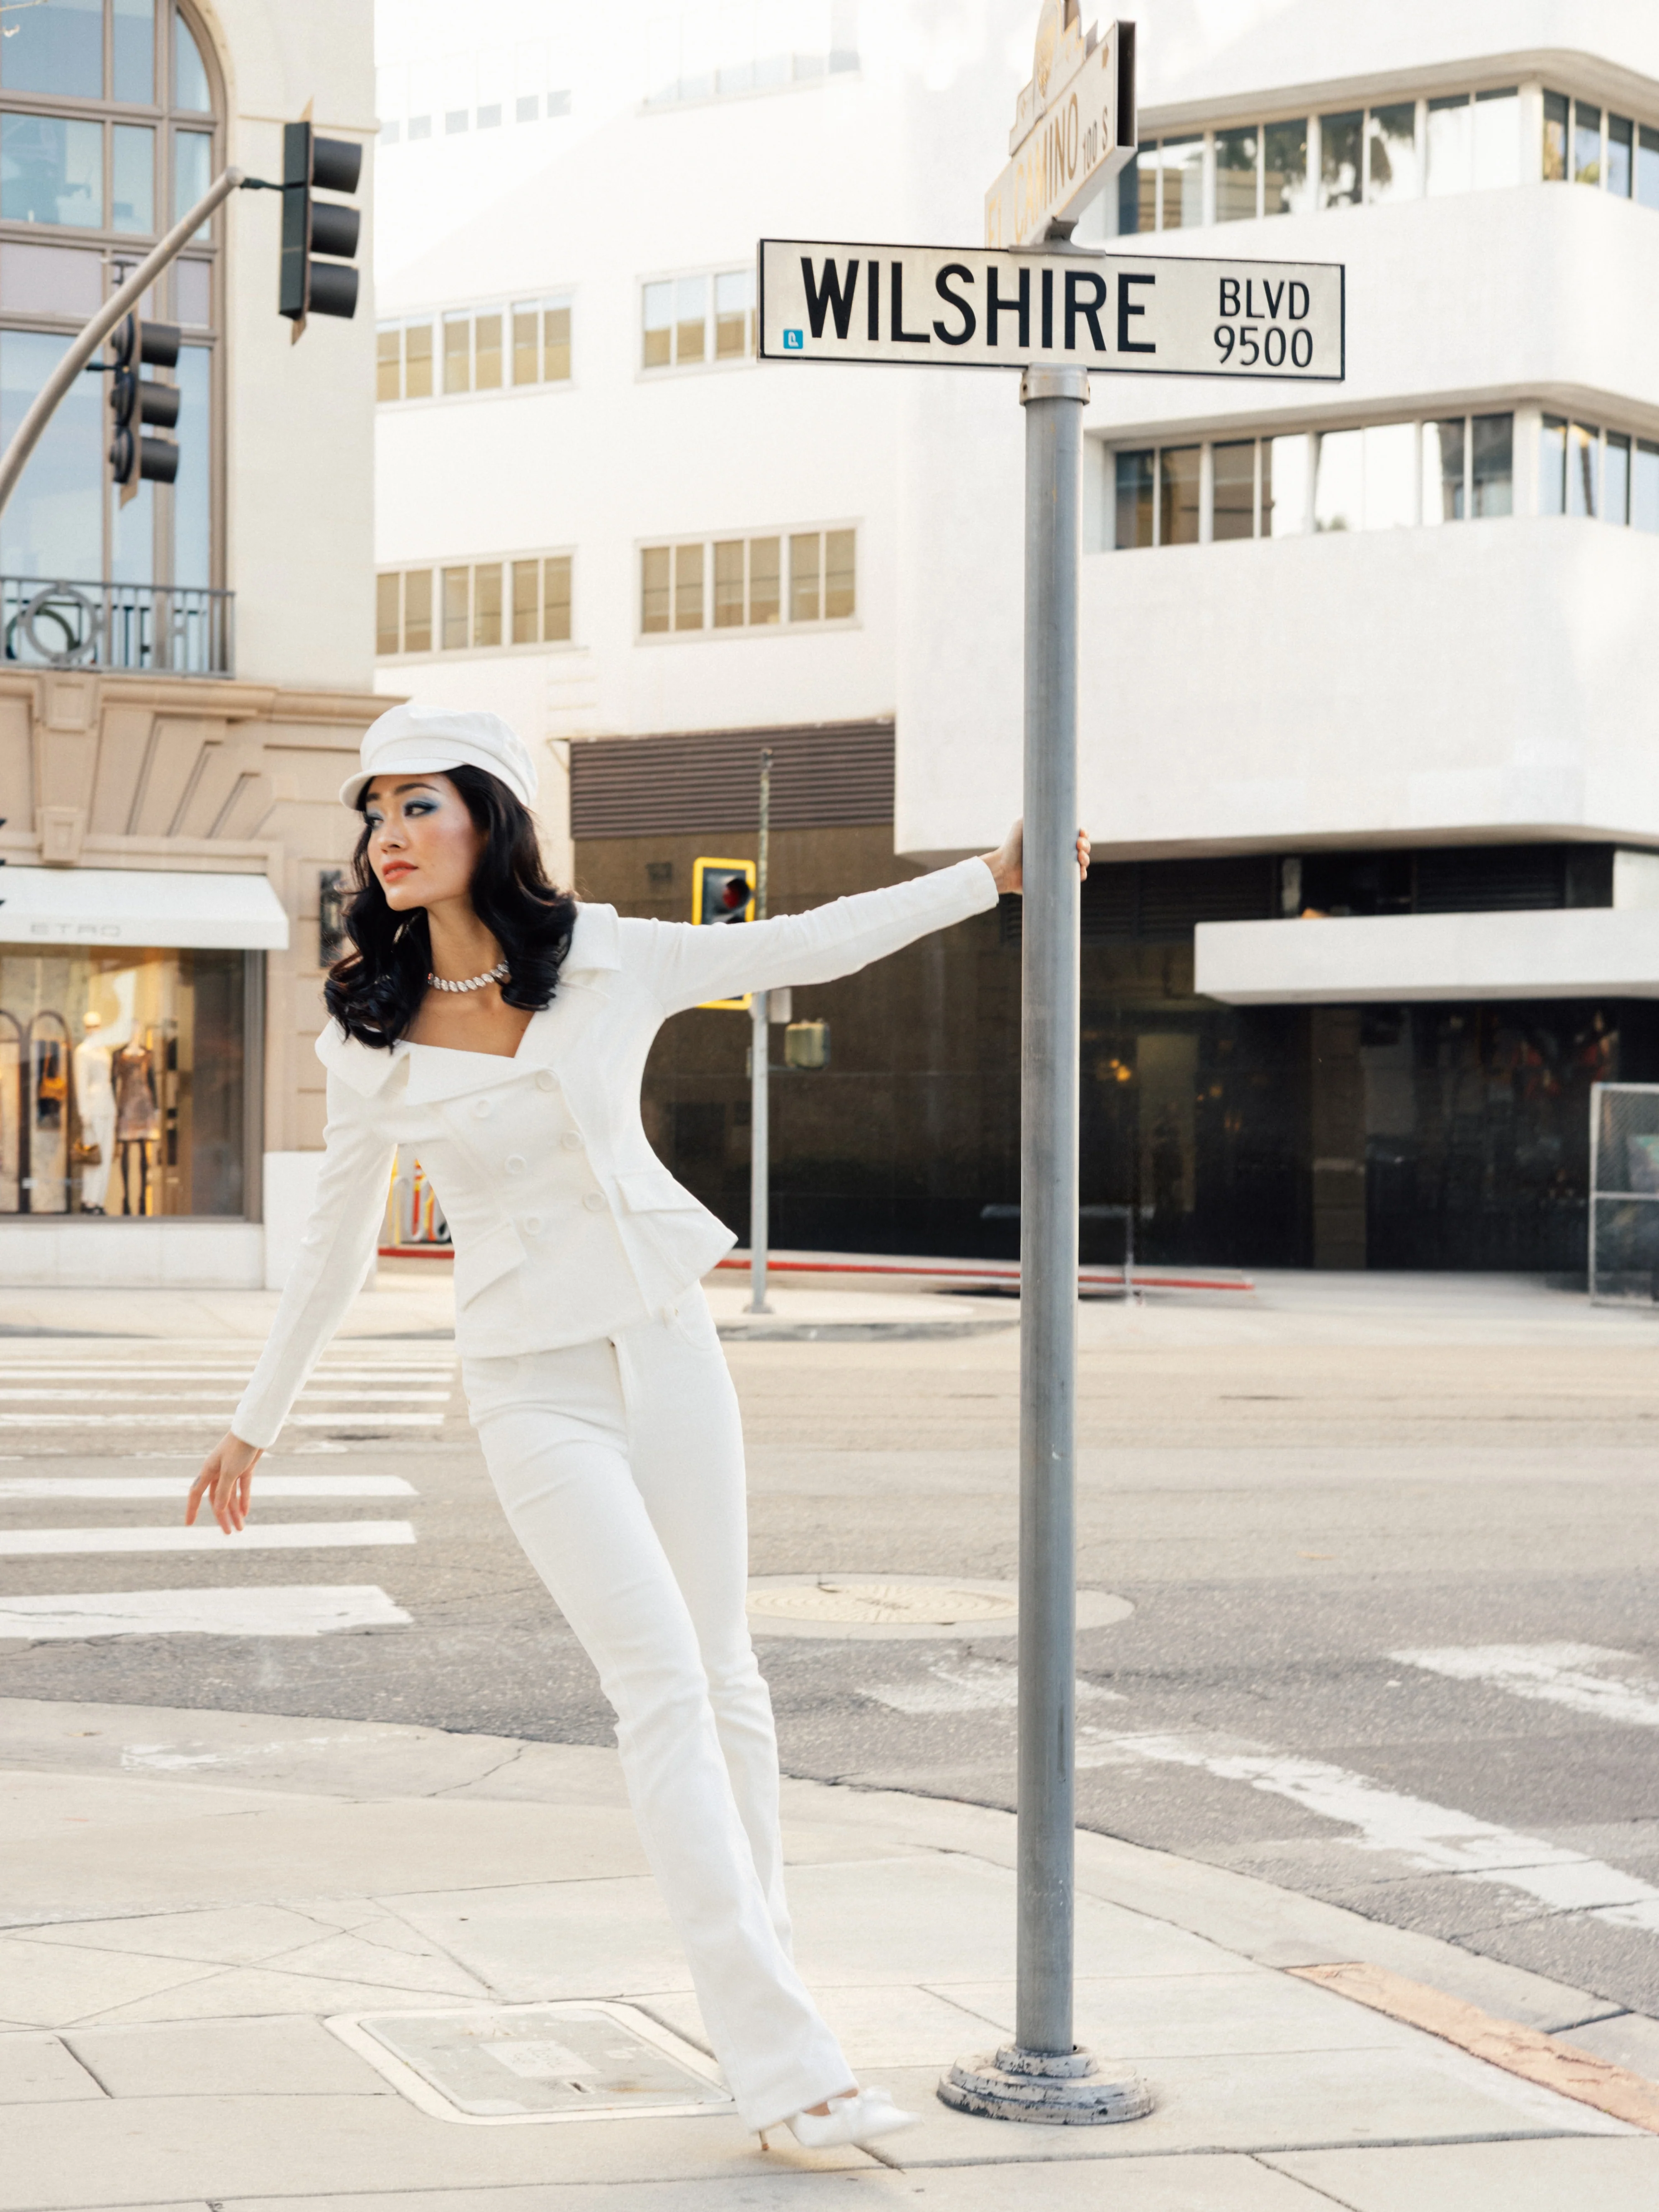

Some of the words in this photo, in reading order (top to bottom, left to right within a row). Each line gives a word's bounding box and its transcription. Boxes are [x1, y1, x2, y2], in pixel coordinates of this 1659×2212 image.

[1014, 92, 1078, 246] CAMINO
[1082, 119, 1097, 175] 100
[1102, 104, 1108, 151] S
[800, 257, 1156, 353] WILSHIRE
[1220, 278, 1310, 320] BLVD
[1214, 325, 1313, 367] 9500
[30, 922, 121, 938] ETRO
